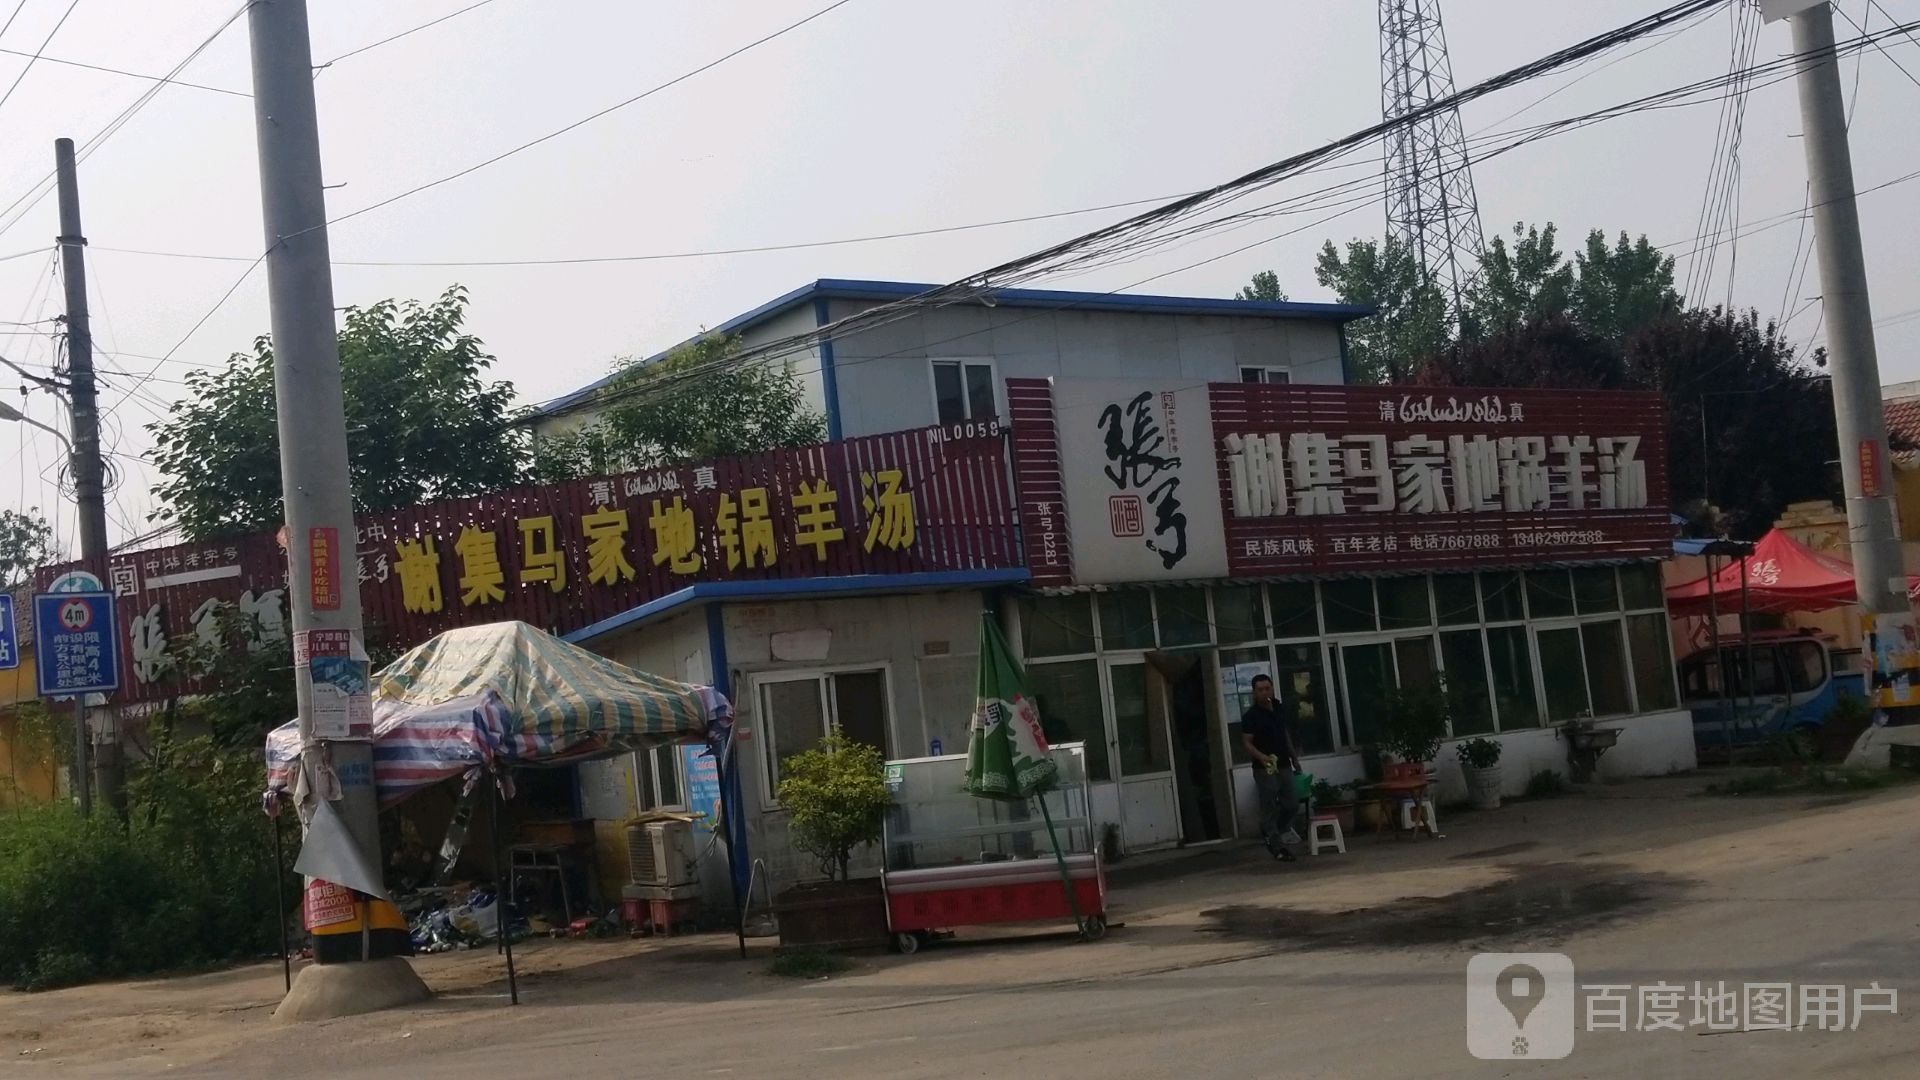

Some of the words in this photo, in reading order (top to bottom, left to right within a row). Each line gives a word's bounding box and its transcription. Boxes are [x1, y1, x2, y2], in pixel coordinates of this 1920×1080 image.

[1379, 401, 1396, 423] 清
[1509, 402, 1525, 422] 真
[588, 482, 611, 507] 清
[693, 466, 717, 492] 真
[1224, 432, 1647, 518] 谢集马家地锅羊汤
[394, 470, 915, 615] 谢集马家地锅羊汤
[1245, 538, 1315, 556] 民族风味
[1331, 536, 1398, 553] 百年老店
[1410, 534, 1500, 550] 电话7667888
[146, 547, 238, 573] 中华老字号
[64, 608, 85, 622] 4m
[84, 631, 102, 684] 限高4米
